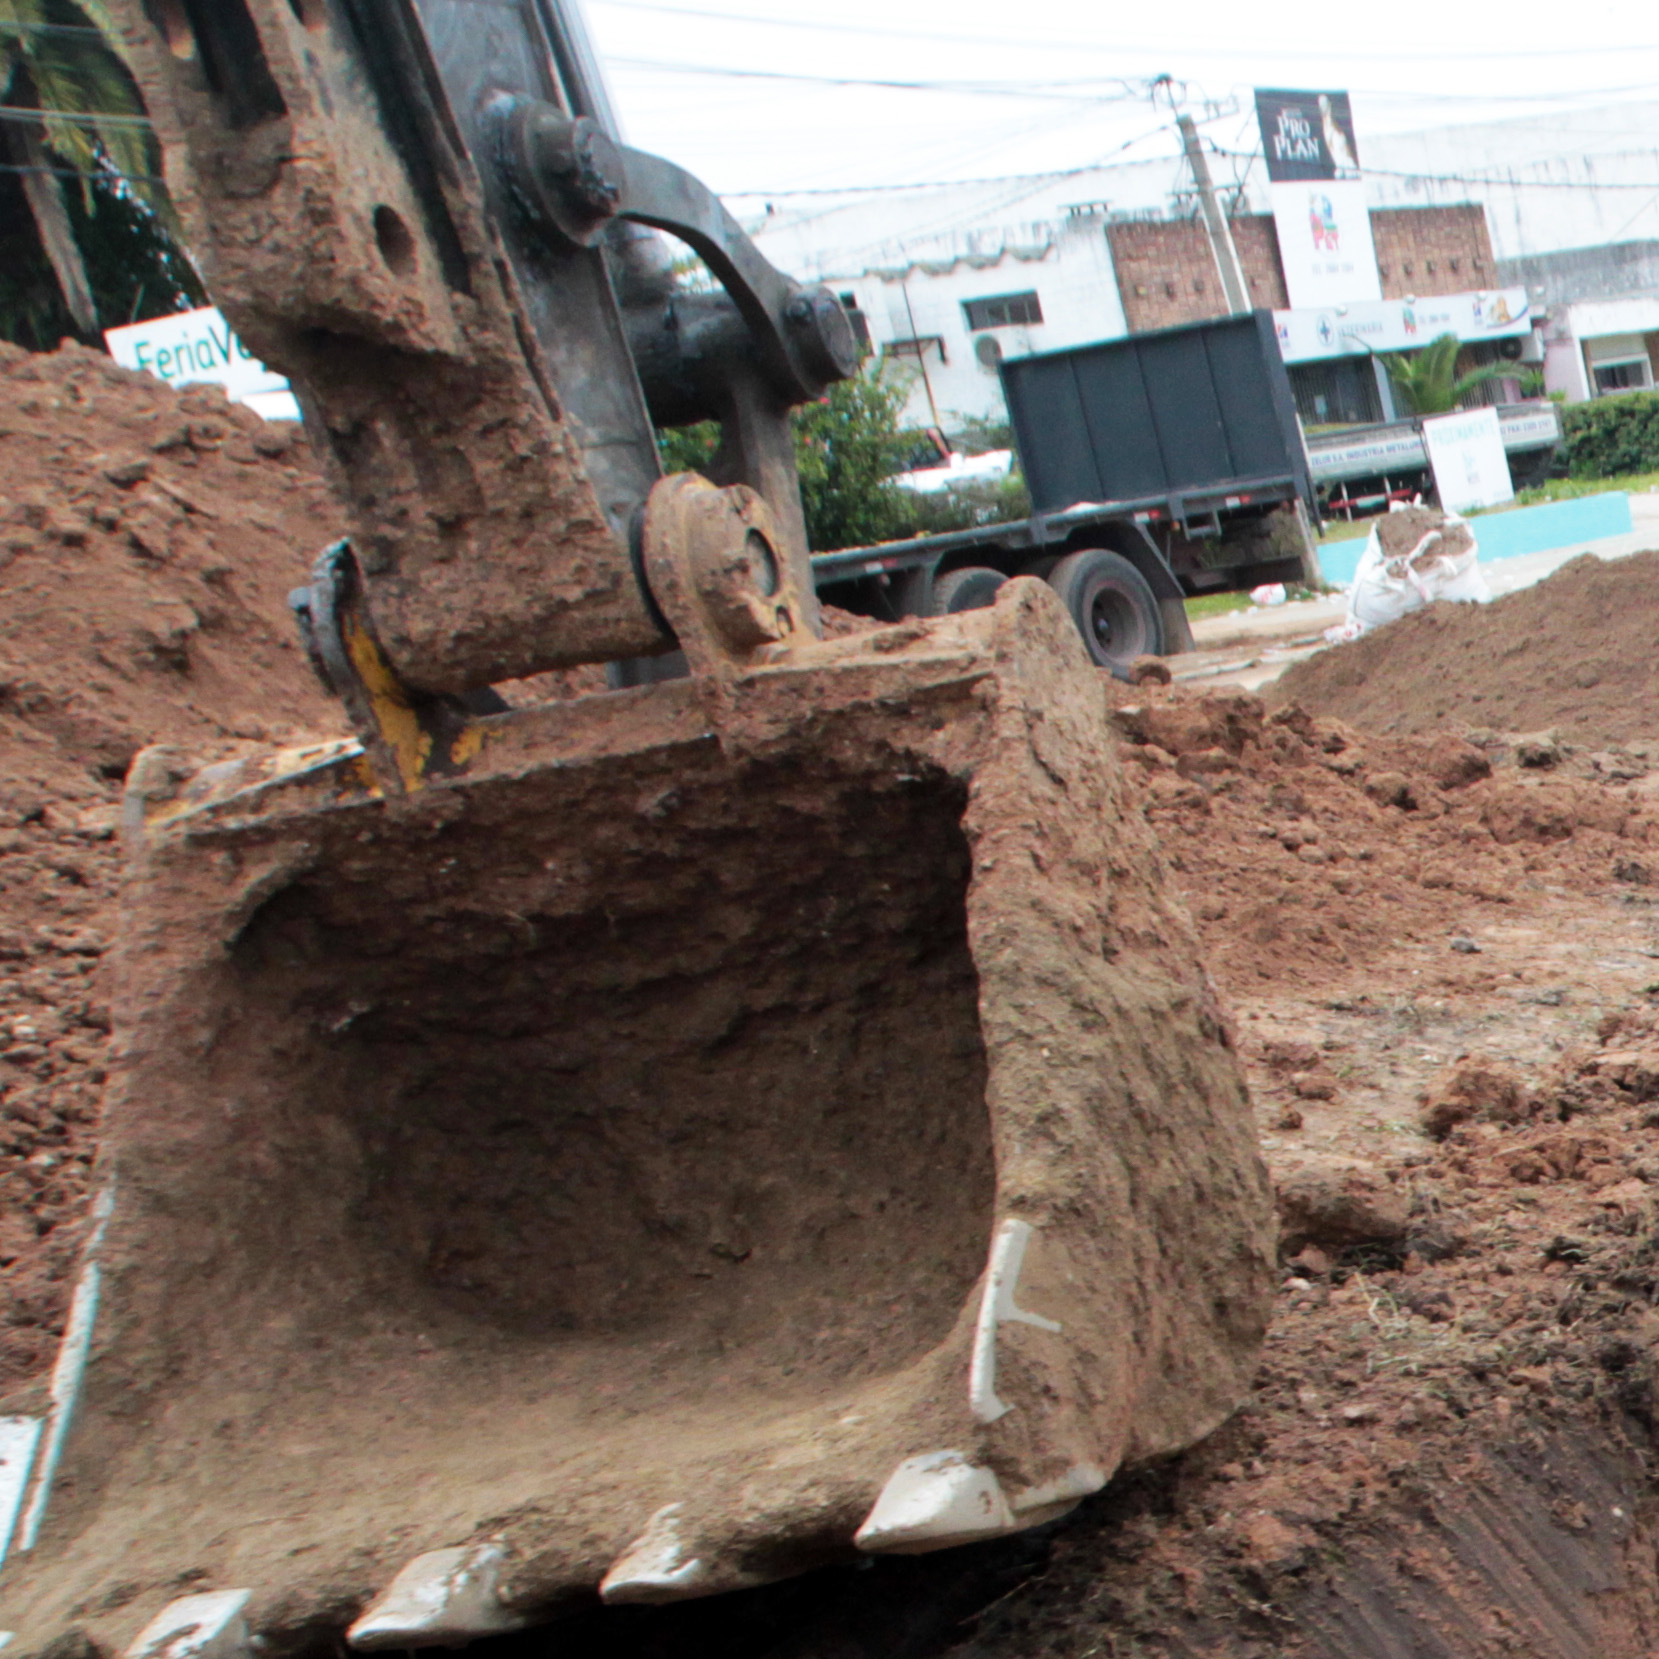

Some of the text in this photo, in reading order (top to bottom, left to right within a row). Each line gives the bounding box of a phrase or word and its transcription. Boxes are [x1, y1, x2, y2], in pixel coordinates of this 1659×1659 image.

[1276, 115, 1311, 139] PRO
[1272, 134, 1320, 161] PLAN
[1346, 446, 1384, 461] INDUSTRIA
